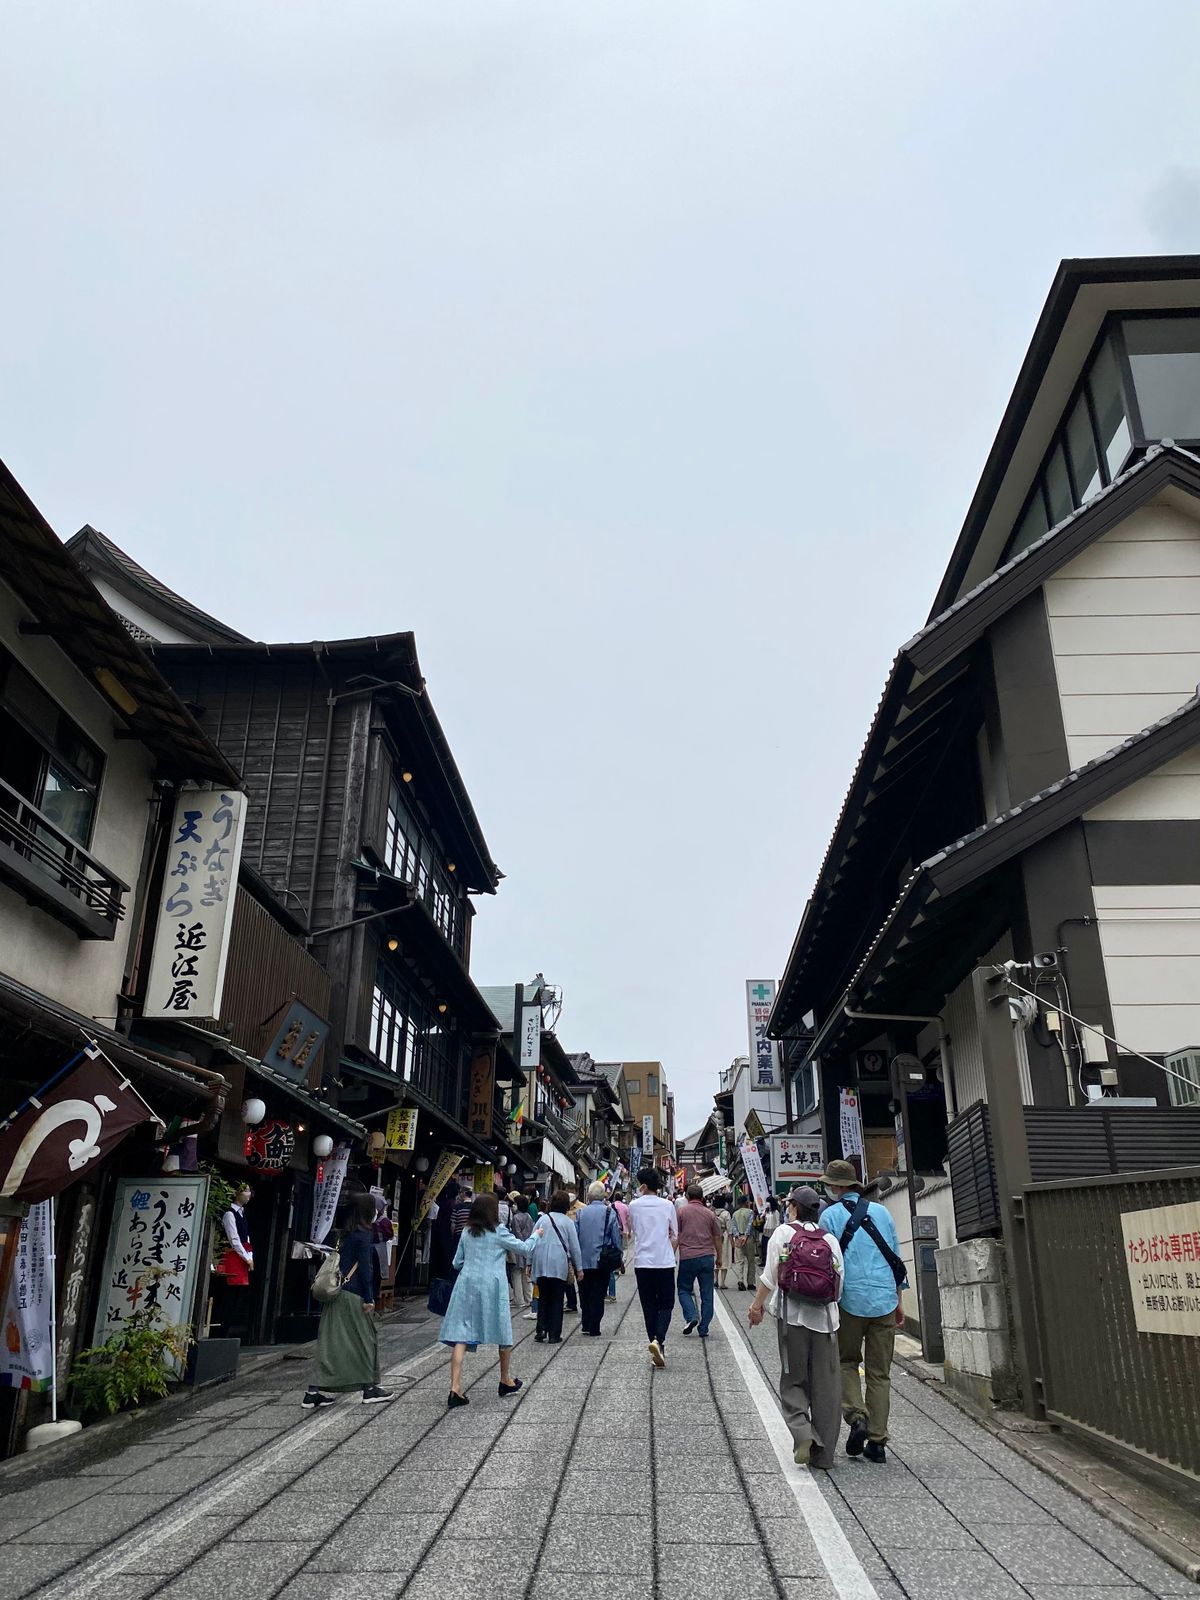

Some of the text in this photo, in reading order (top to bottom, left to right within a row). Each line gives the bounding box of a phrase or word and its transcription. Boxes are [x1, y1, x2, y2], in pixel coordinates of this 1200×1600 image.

[165, 811, 202, 918] 天ぷら
[200, 794, 234, 907] うなぎ
[163, 922, 207, 1010] 近江屋
[396, 1110, 410, 1147] 整理券
[780, 1151, 825, 1165] 大草胃
[142, 1191, 171, 1266] うなぎ
[165, 1197, 195, 1301] 御食事処
